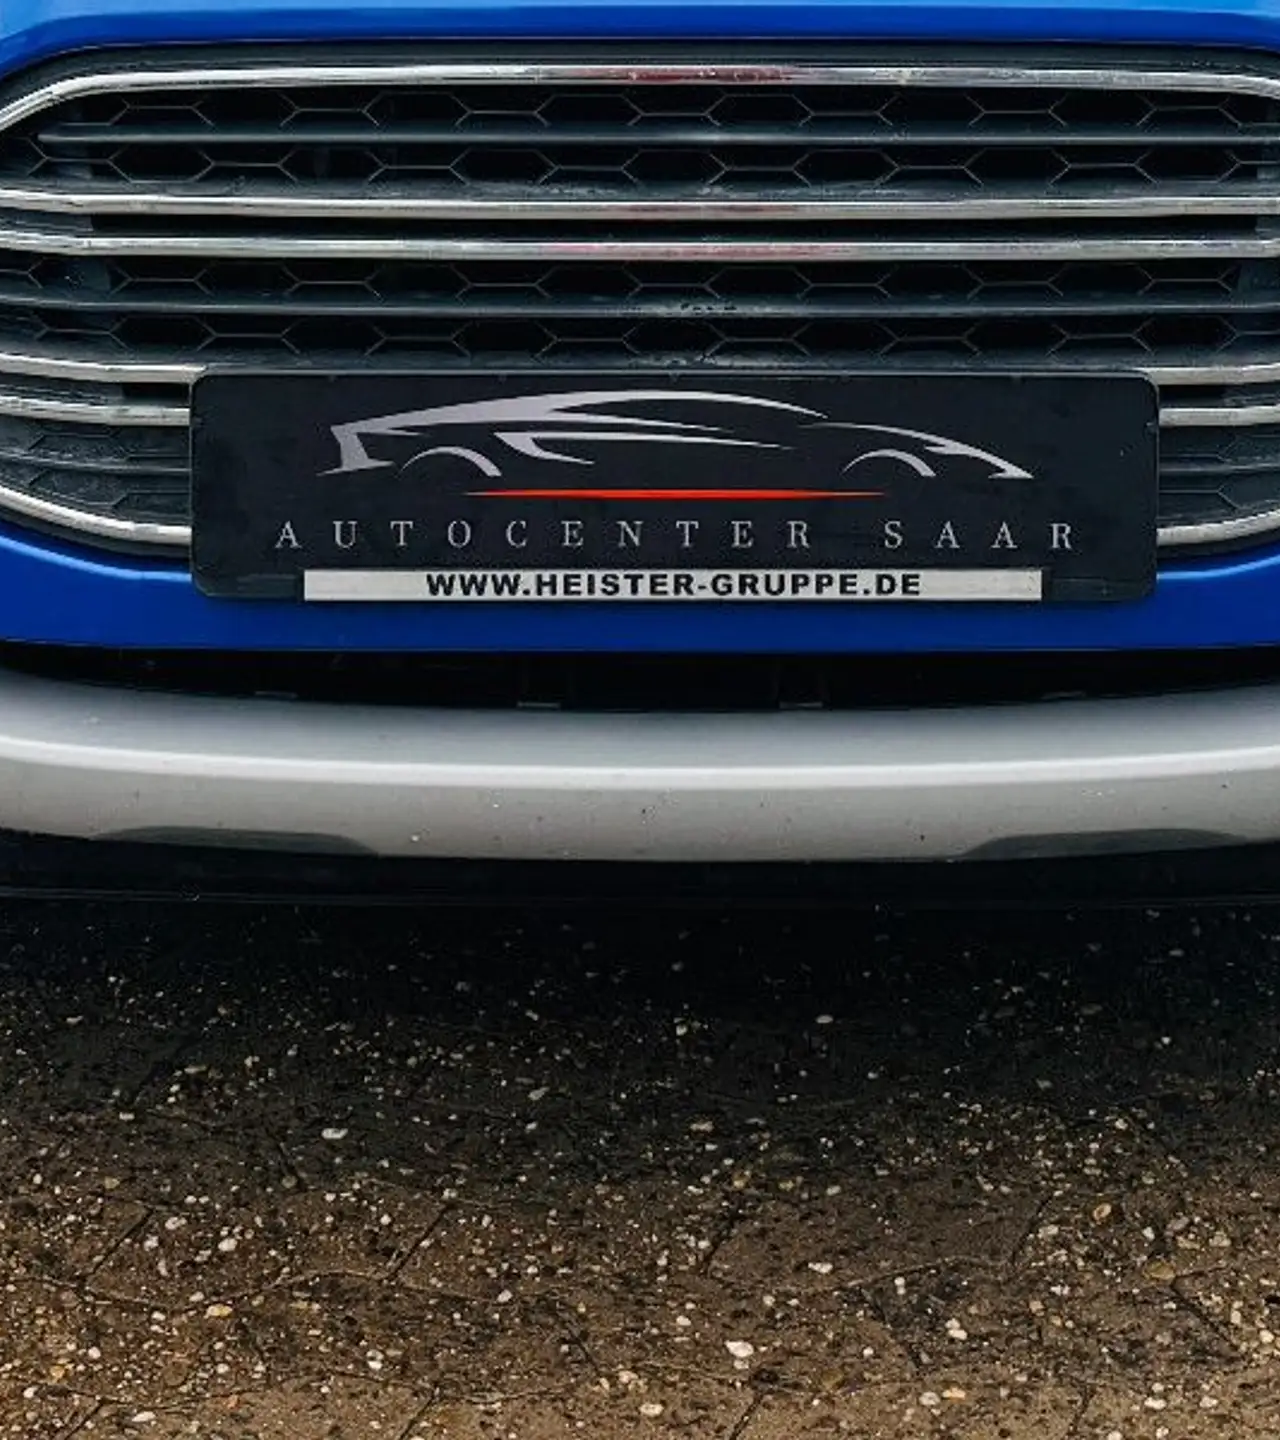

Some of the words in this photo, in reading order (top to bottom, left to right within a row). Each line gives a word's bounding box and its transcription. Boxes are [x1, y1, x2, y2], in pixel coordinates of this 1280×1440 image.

[273, 520, 812, 549] AUTOCENTER
[883, 520, 1073, 549] SAAR
[426, 573, 921, 597] WWW.HEISTER-GRUPPE.DE
